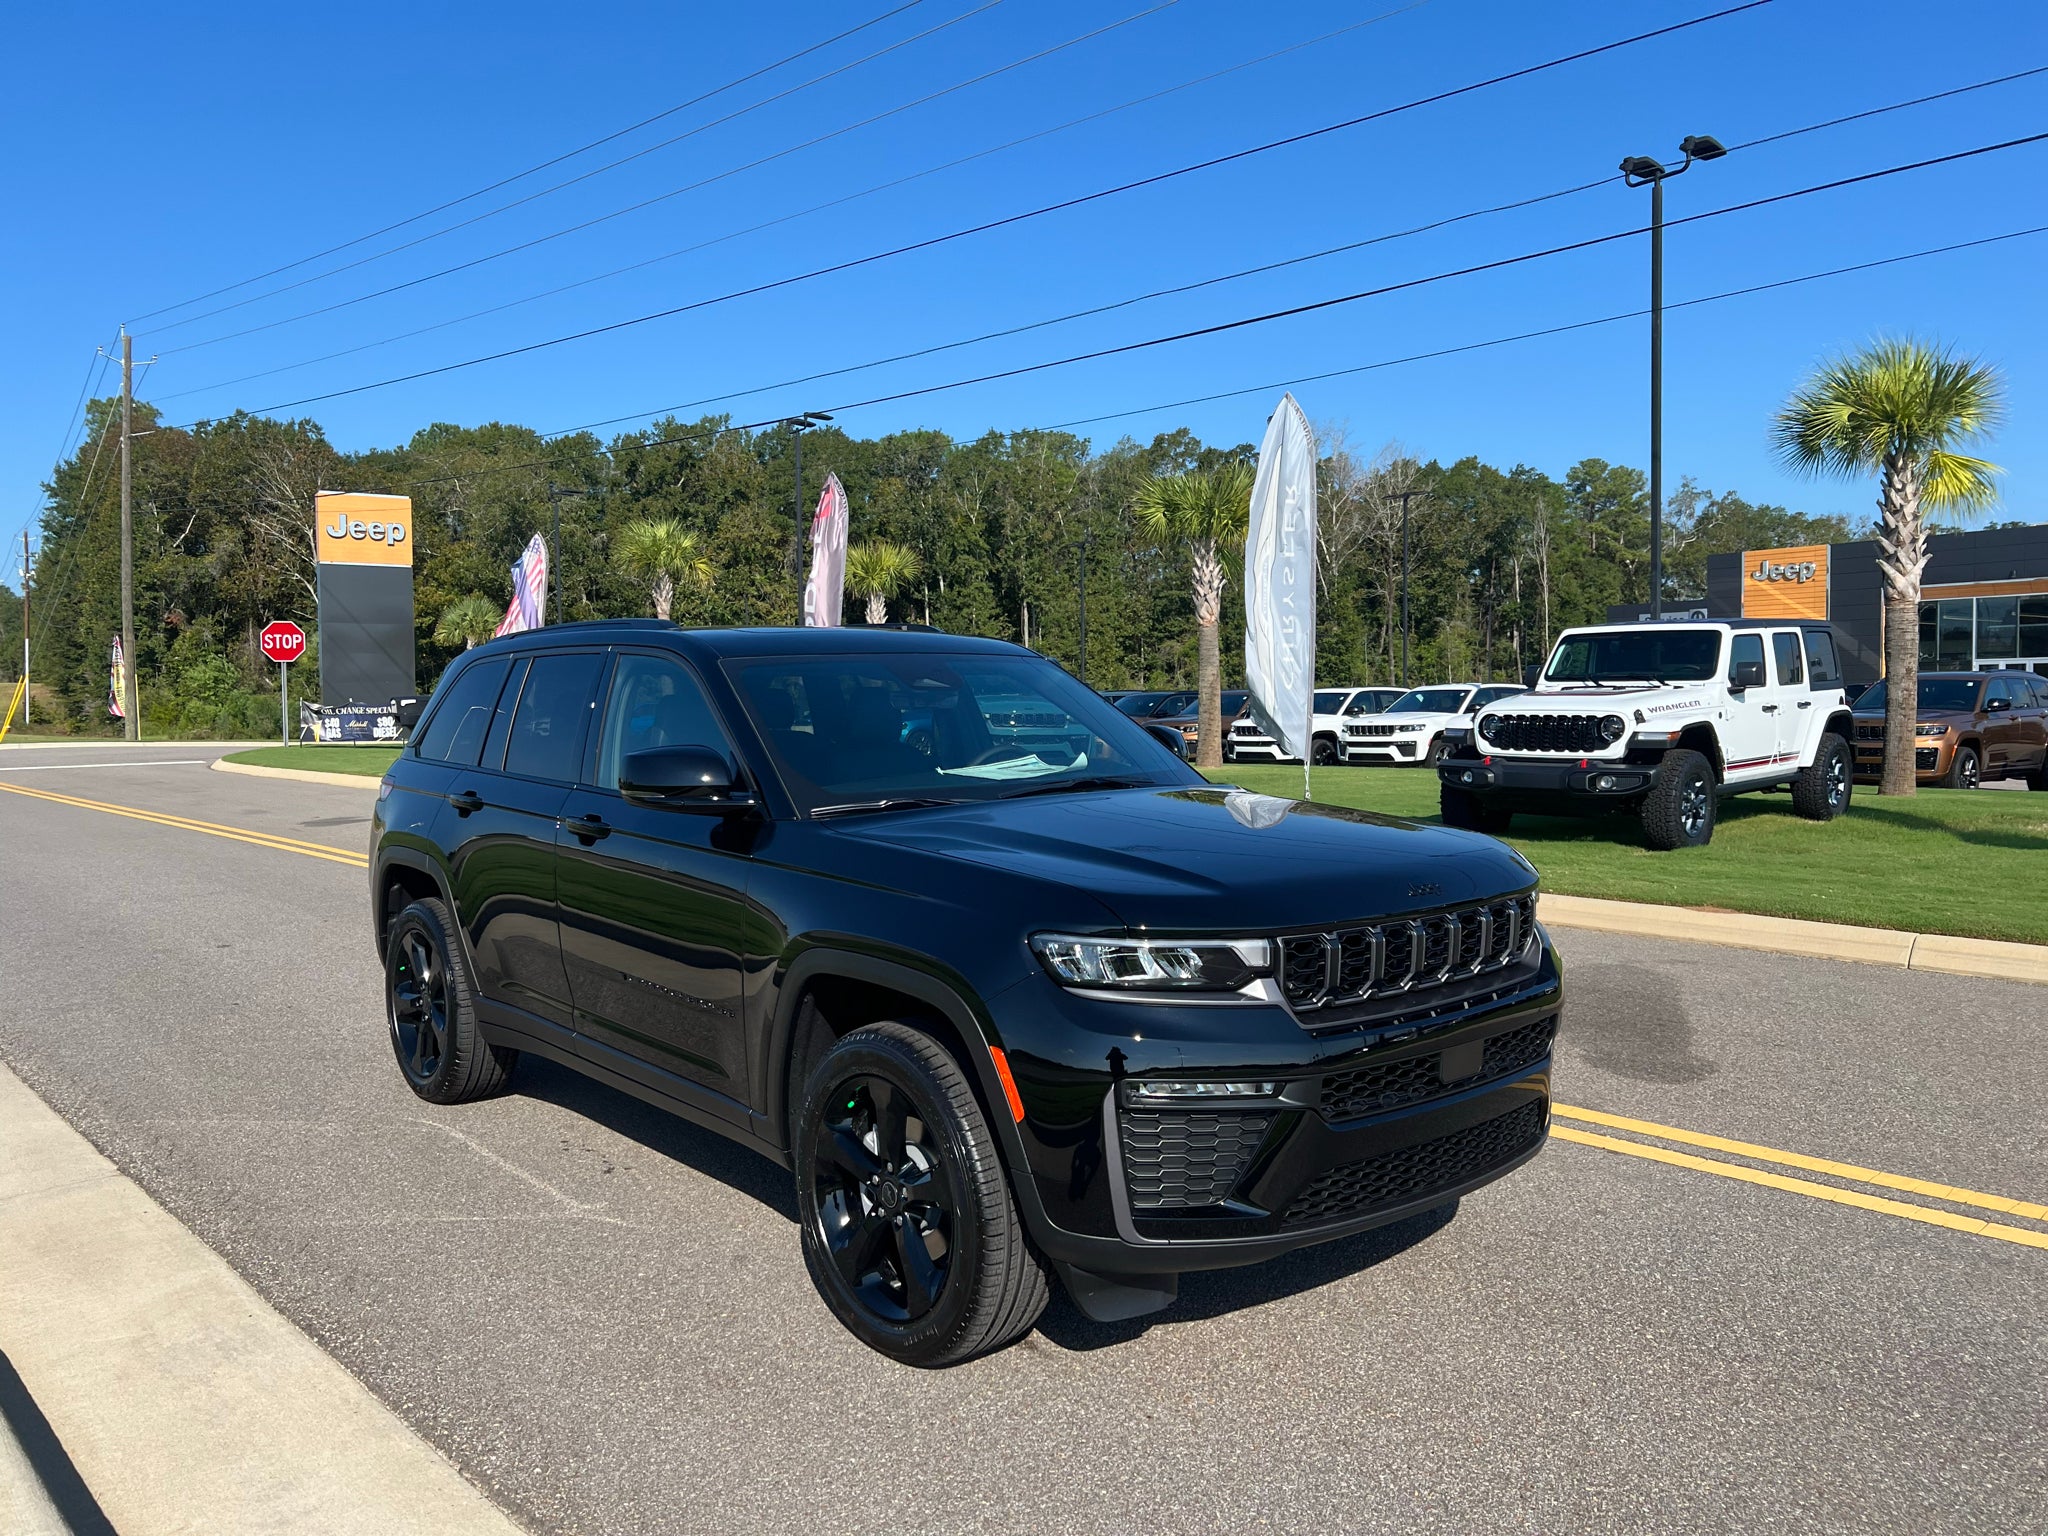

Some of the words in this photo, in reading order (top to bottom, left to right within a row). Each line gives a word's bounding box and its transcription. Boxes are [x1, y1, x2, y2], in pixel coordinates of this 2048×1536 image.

[326, 514, 406, 546] Jeep
[1751, 560, 1816, 584] Jeep
[264, 634, 302, 649] STOP
[336, 706, 365, 714] CHANGE
[366, 706, 392, 714] SPECIA
[1648, 700, 1701, 714] WRANGLER
[325, 717, 340, 728] $40
[376, 716, 394, 728] $80
[326, 728, 342, 738] GAS
[373, 727, 397, 738] DIESEL
